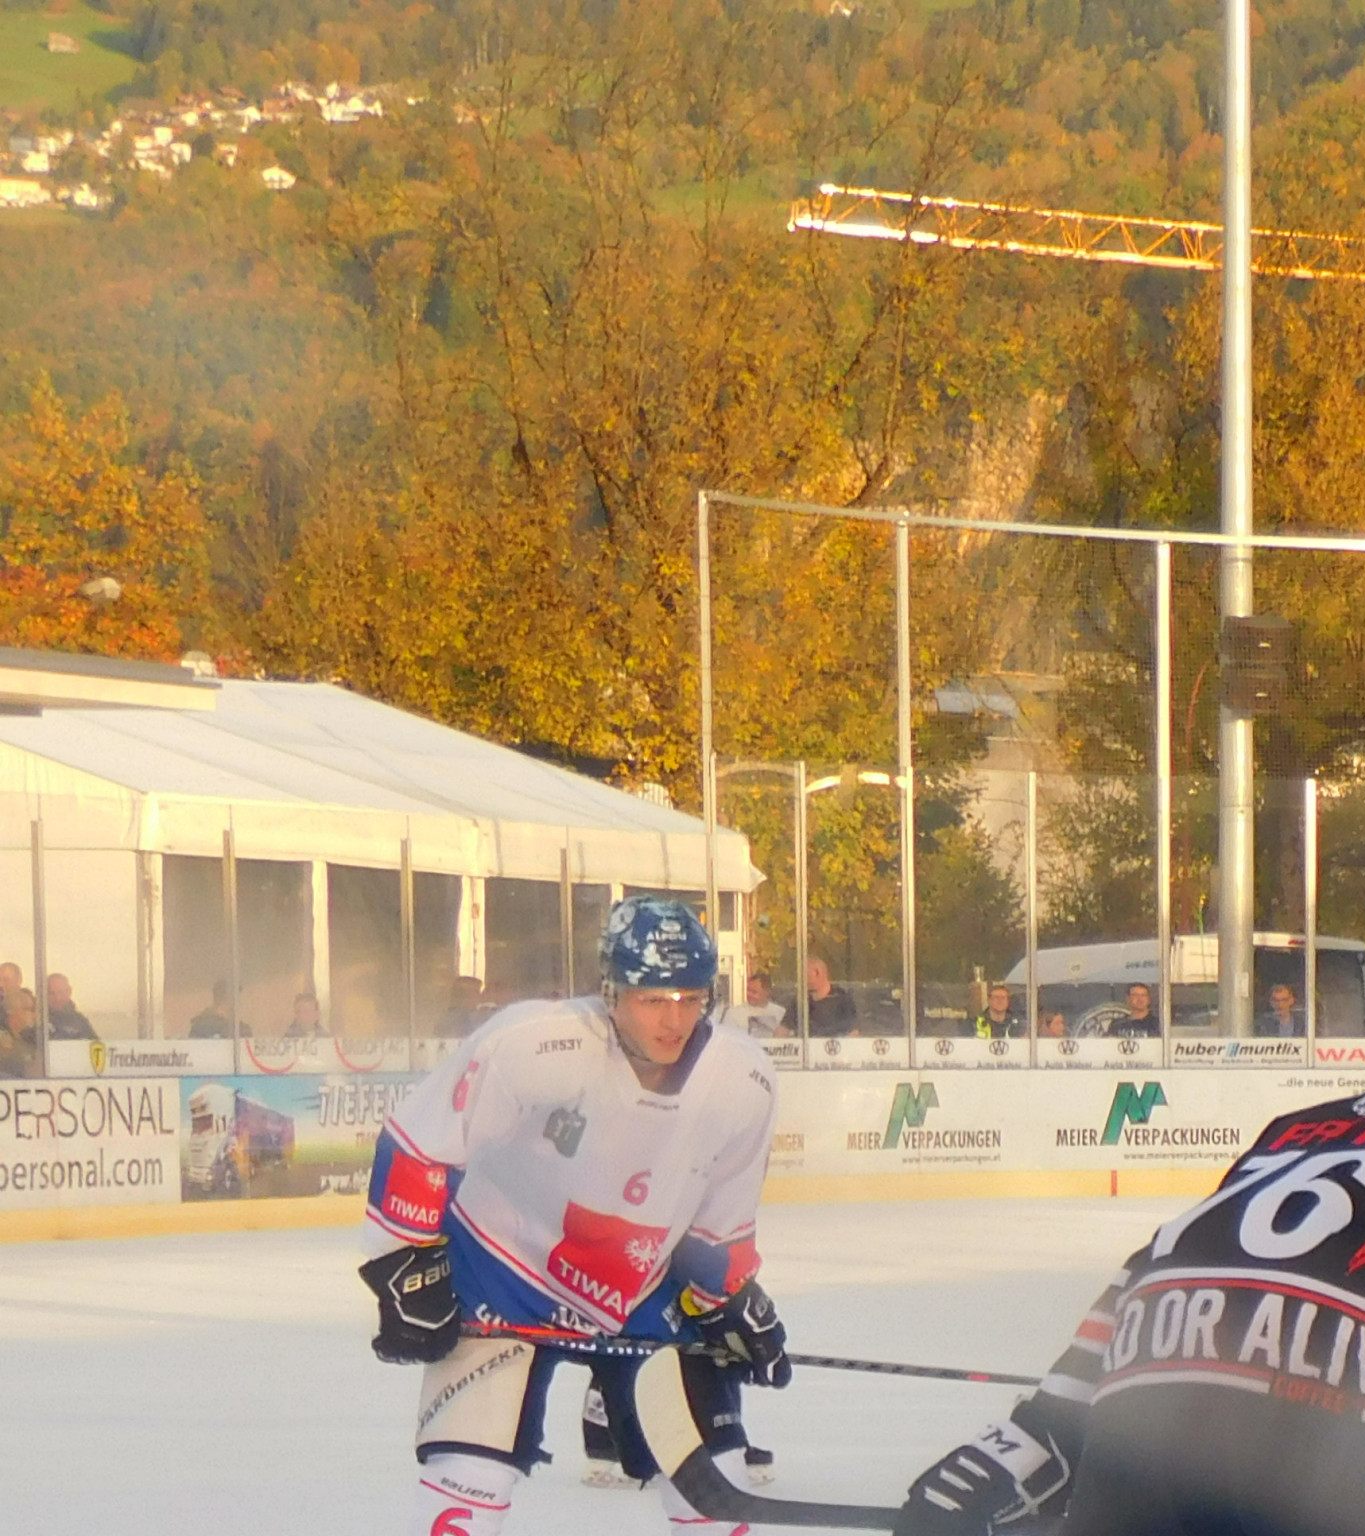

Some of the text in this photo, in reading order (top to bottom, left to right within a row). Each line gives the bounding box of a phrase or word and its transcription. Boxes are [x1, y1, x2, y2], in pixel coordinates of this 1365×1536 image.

[763, 1043, 800, 1057] untlix
[1174, 1042, 1303, 1057] huber muntlix
[1306, 1080, 1334, 1088] neue
[847, 1129, 1002, 1151] MEIER VERPACKUNGEN
[1055, 1127, 1241, 1147] MEIER VERPACKUNGEN
[622, 1169, 653, 1206] 6
[390, 1194, 440, 1225] TIWAG
[559, 1256, 629, 1317] TIWA
[1151, 1288, 1226, 1360] OR
